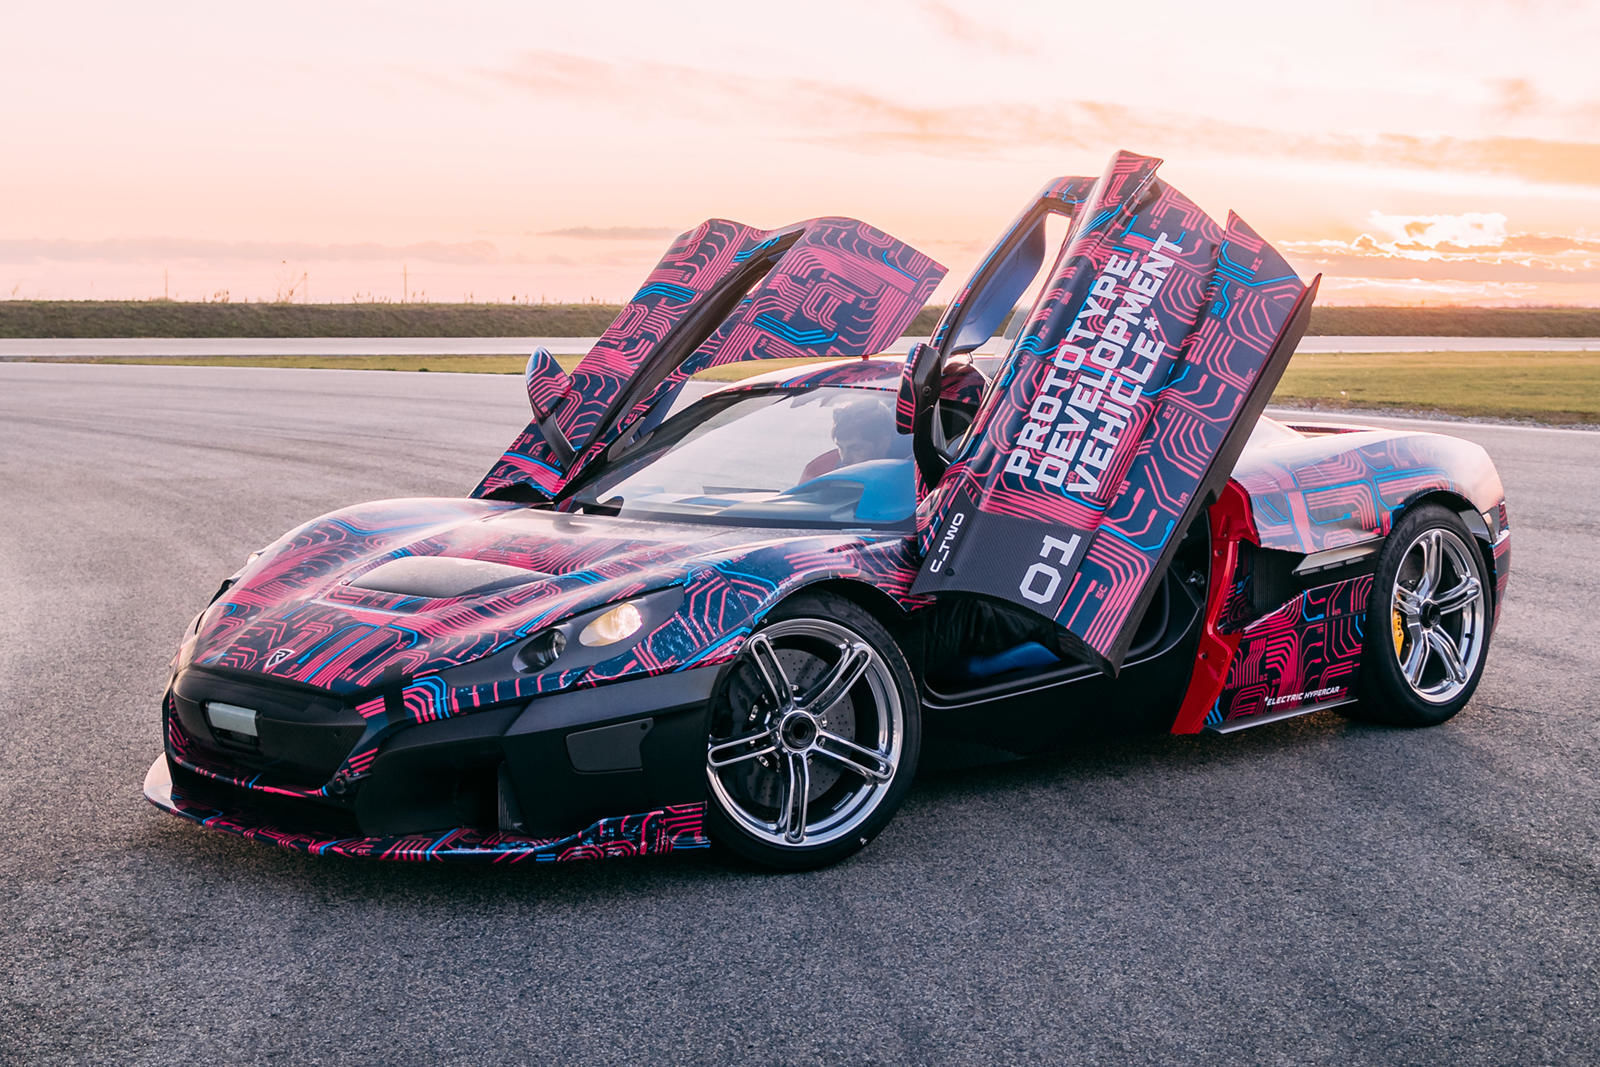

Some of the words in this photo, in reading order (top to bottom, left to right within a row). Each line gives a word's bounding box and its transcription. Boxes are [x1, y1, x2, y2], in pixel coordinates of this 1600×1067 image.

[1006, 254, 1138, 478] PROTOTYPE
[1033, 232, 1183, 488] DEVELOPMENT
[929, 512, 965, 573] C_TWO
[1019, 532, 1082, 605] 01
[1304, 685, 1340, 699] HYPERCAR
